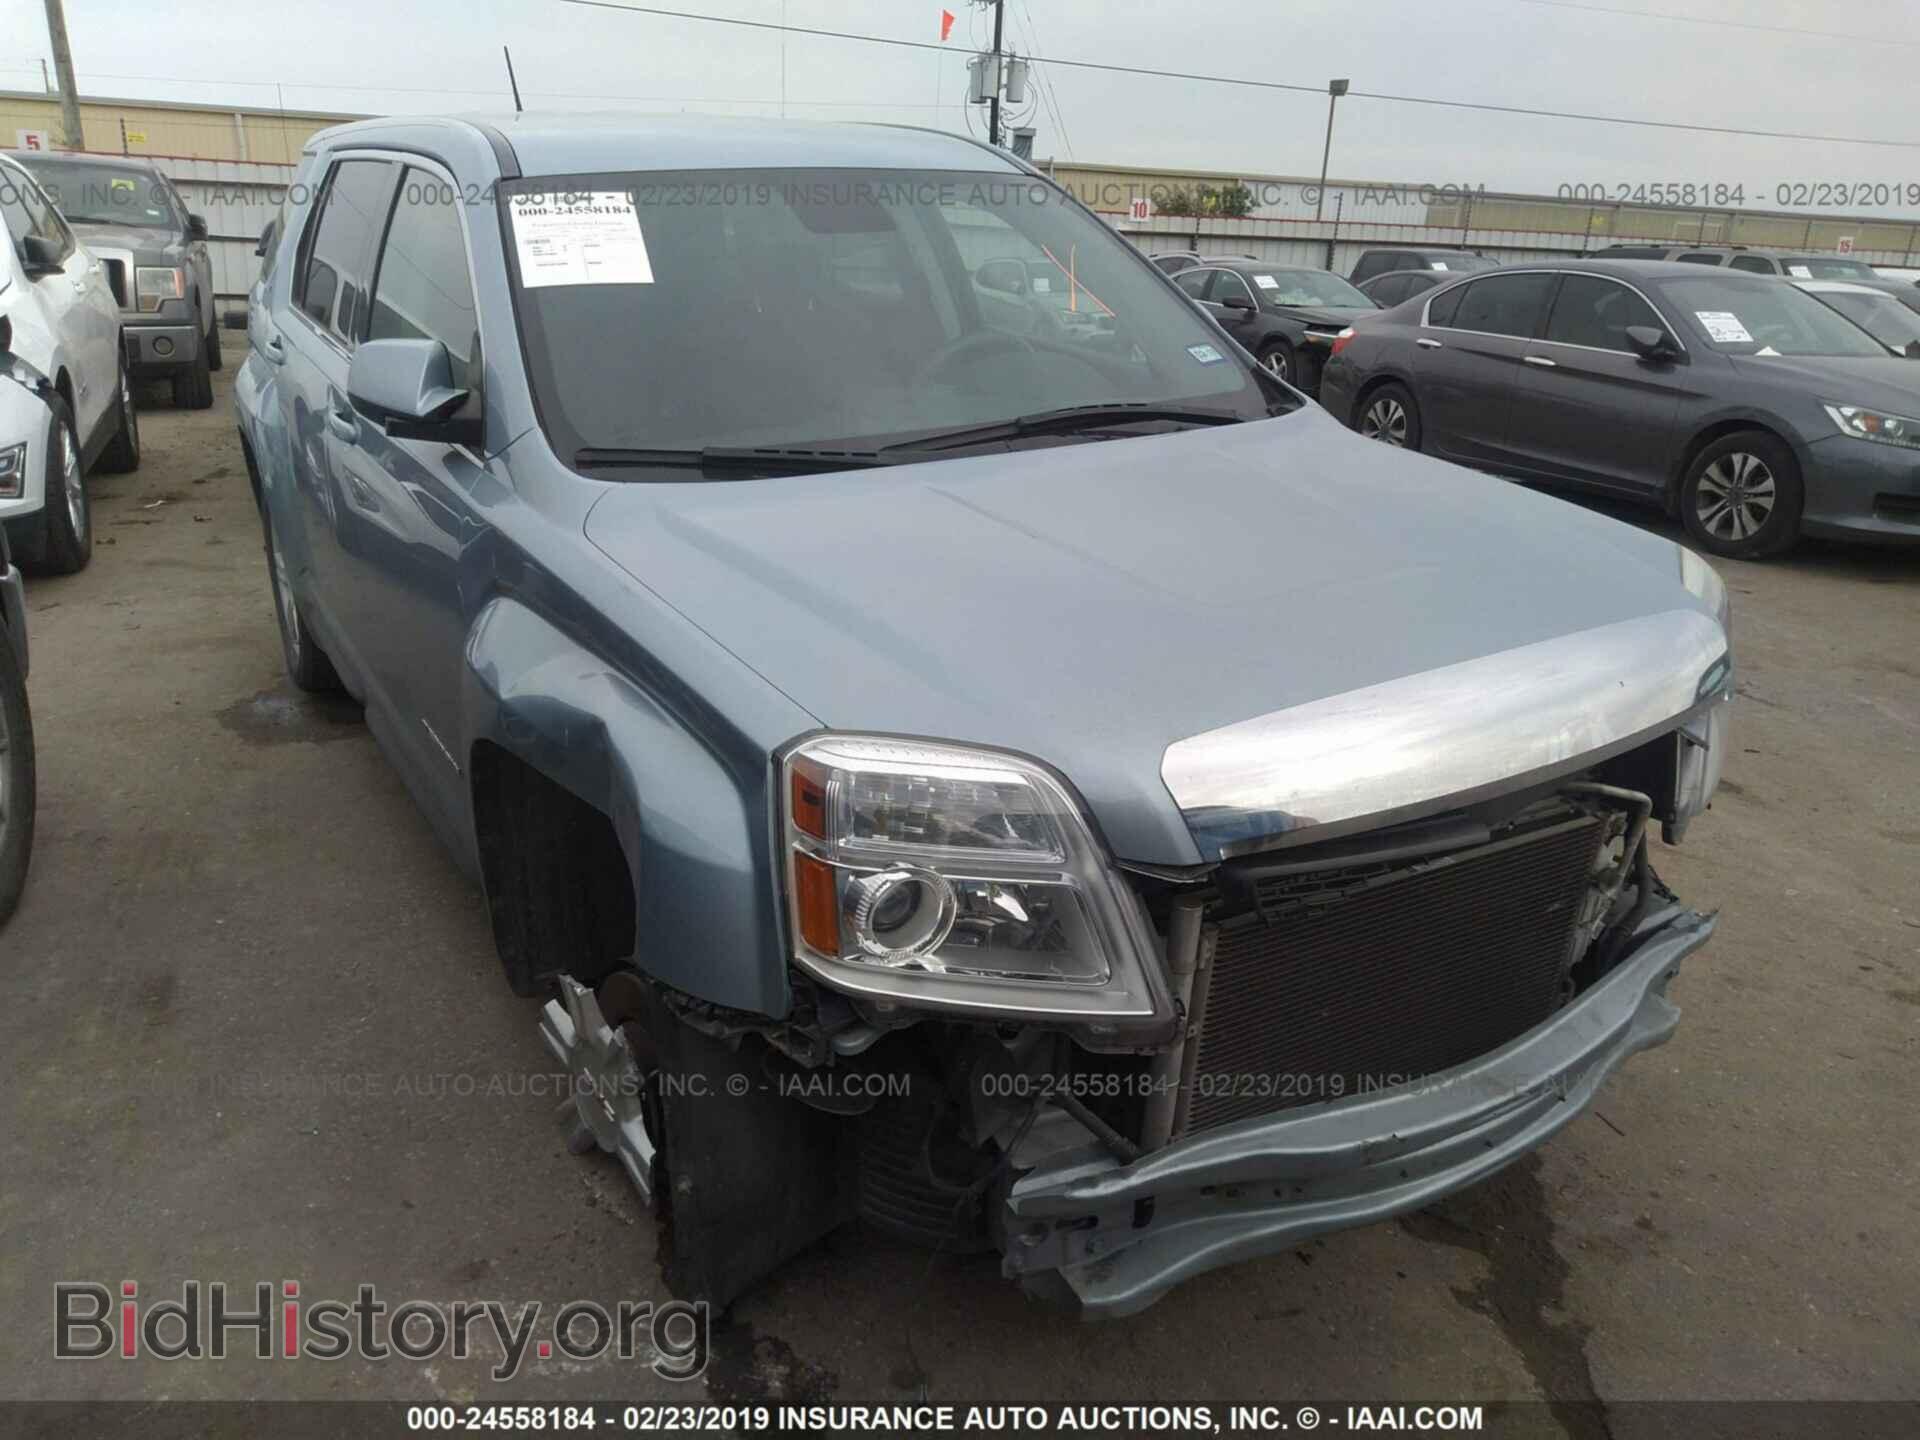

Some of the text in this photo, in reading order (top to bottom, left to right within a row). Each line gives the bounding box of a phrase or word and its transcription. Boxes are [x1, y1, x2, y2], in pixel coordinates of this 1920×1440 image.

[25, 134, 41, 151] 5
[517, 205, 632, 217] 000-24558184
[1134, 201, 1148, 218] 10
